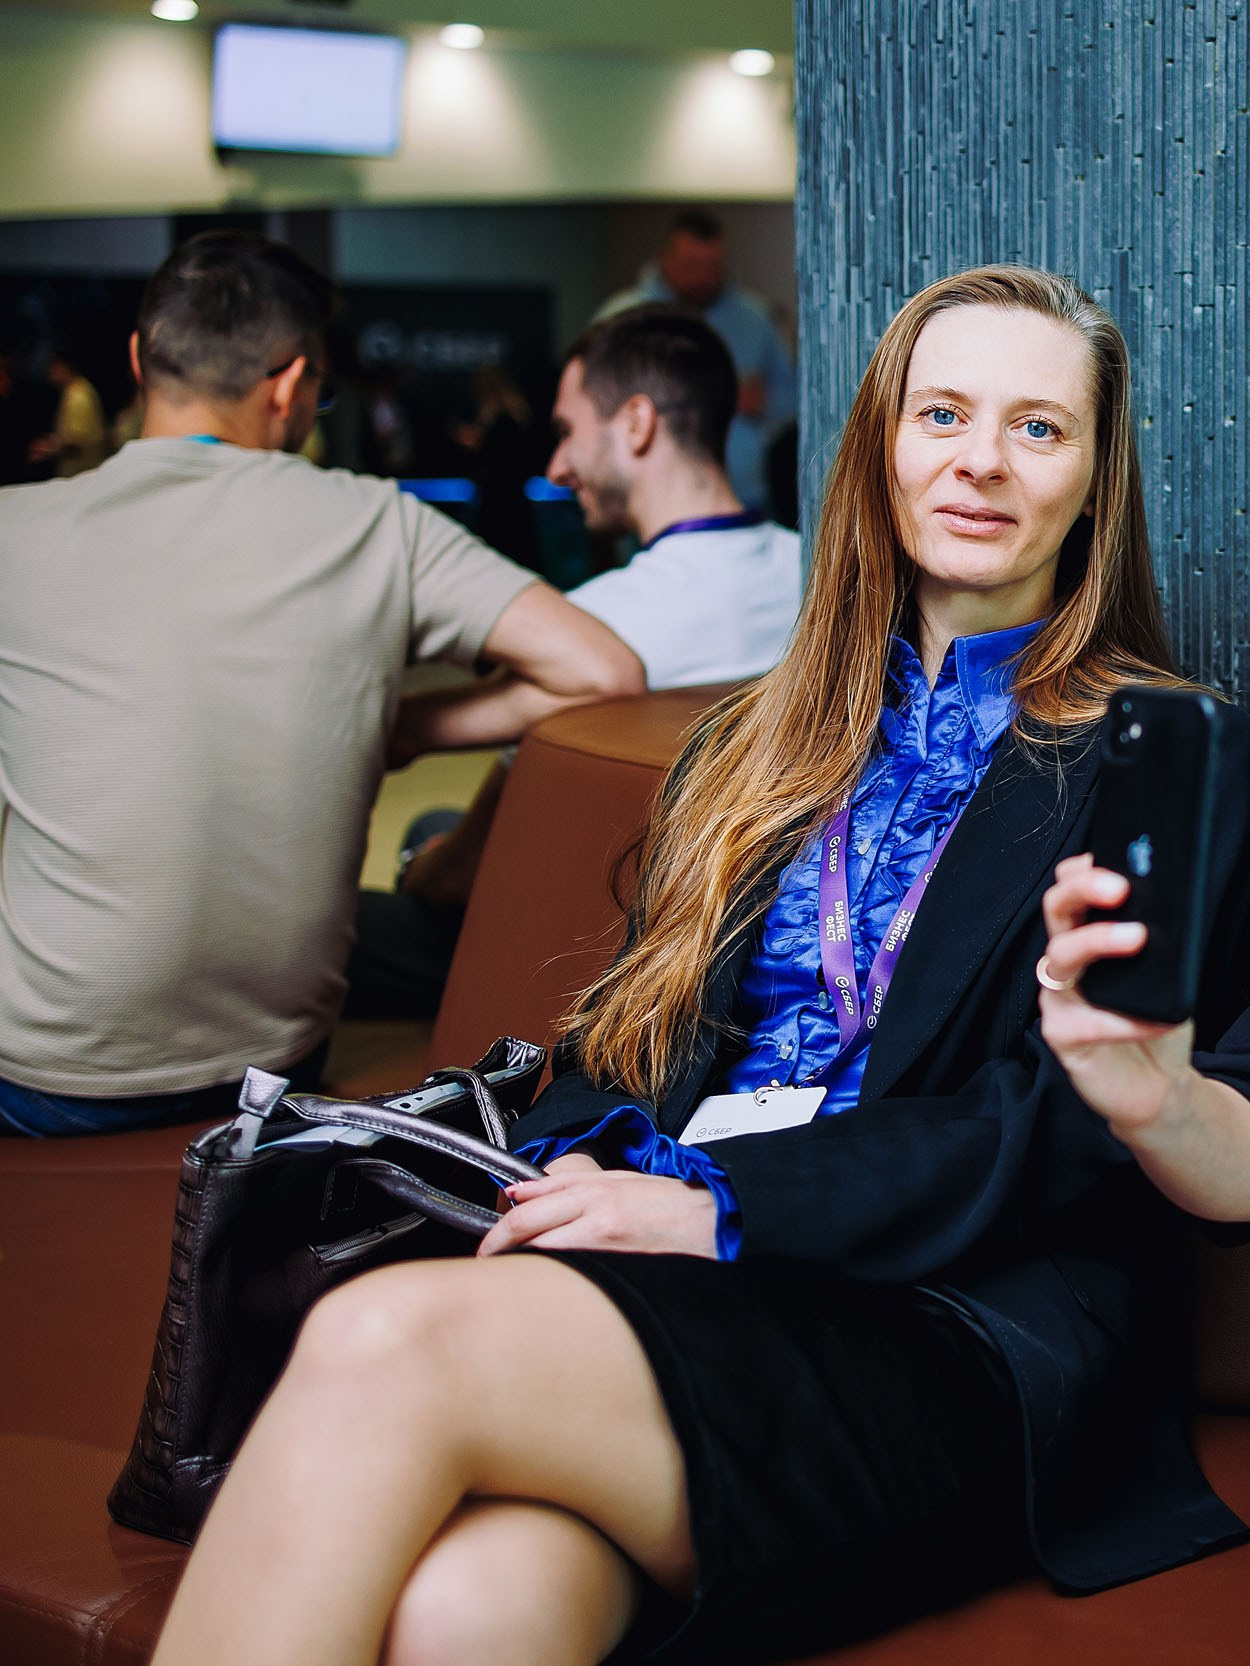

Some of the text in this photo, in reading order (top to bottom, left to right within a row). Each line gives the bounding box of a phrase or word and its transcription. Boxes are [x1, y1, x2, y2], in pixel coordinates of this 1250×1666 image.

[828, 847, 838, 873] СБЕР
[825, 915, 837, 943] ФЕСТ
[834, 900, 847, 942] БИЗНЕС
[885, 909, 911, 952] БИЗНЕС
[841, 989, 854, 1015] СБЕР
[872, 985, 884, 1014] СБЕР
[707, 1127, 733, 1136] СБЕР
